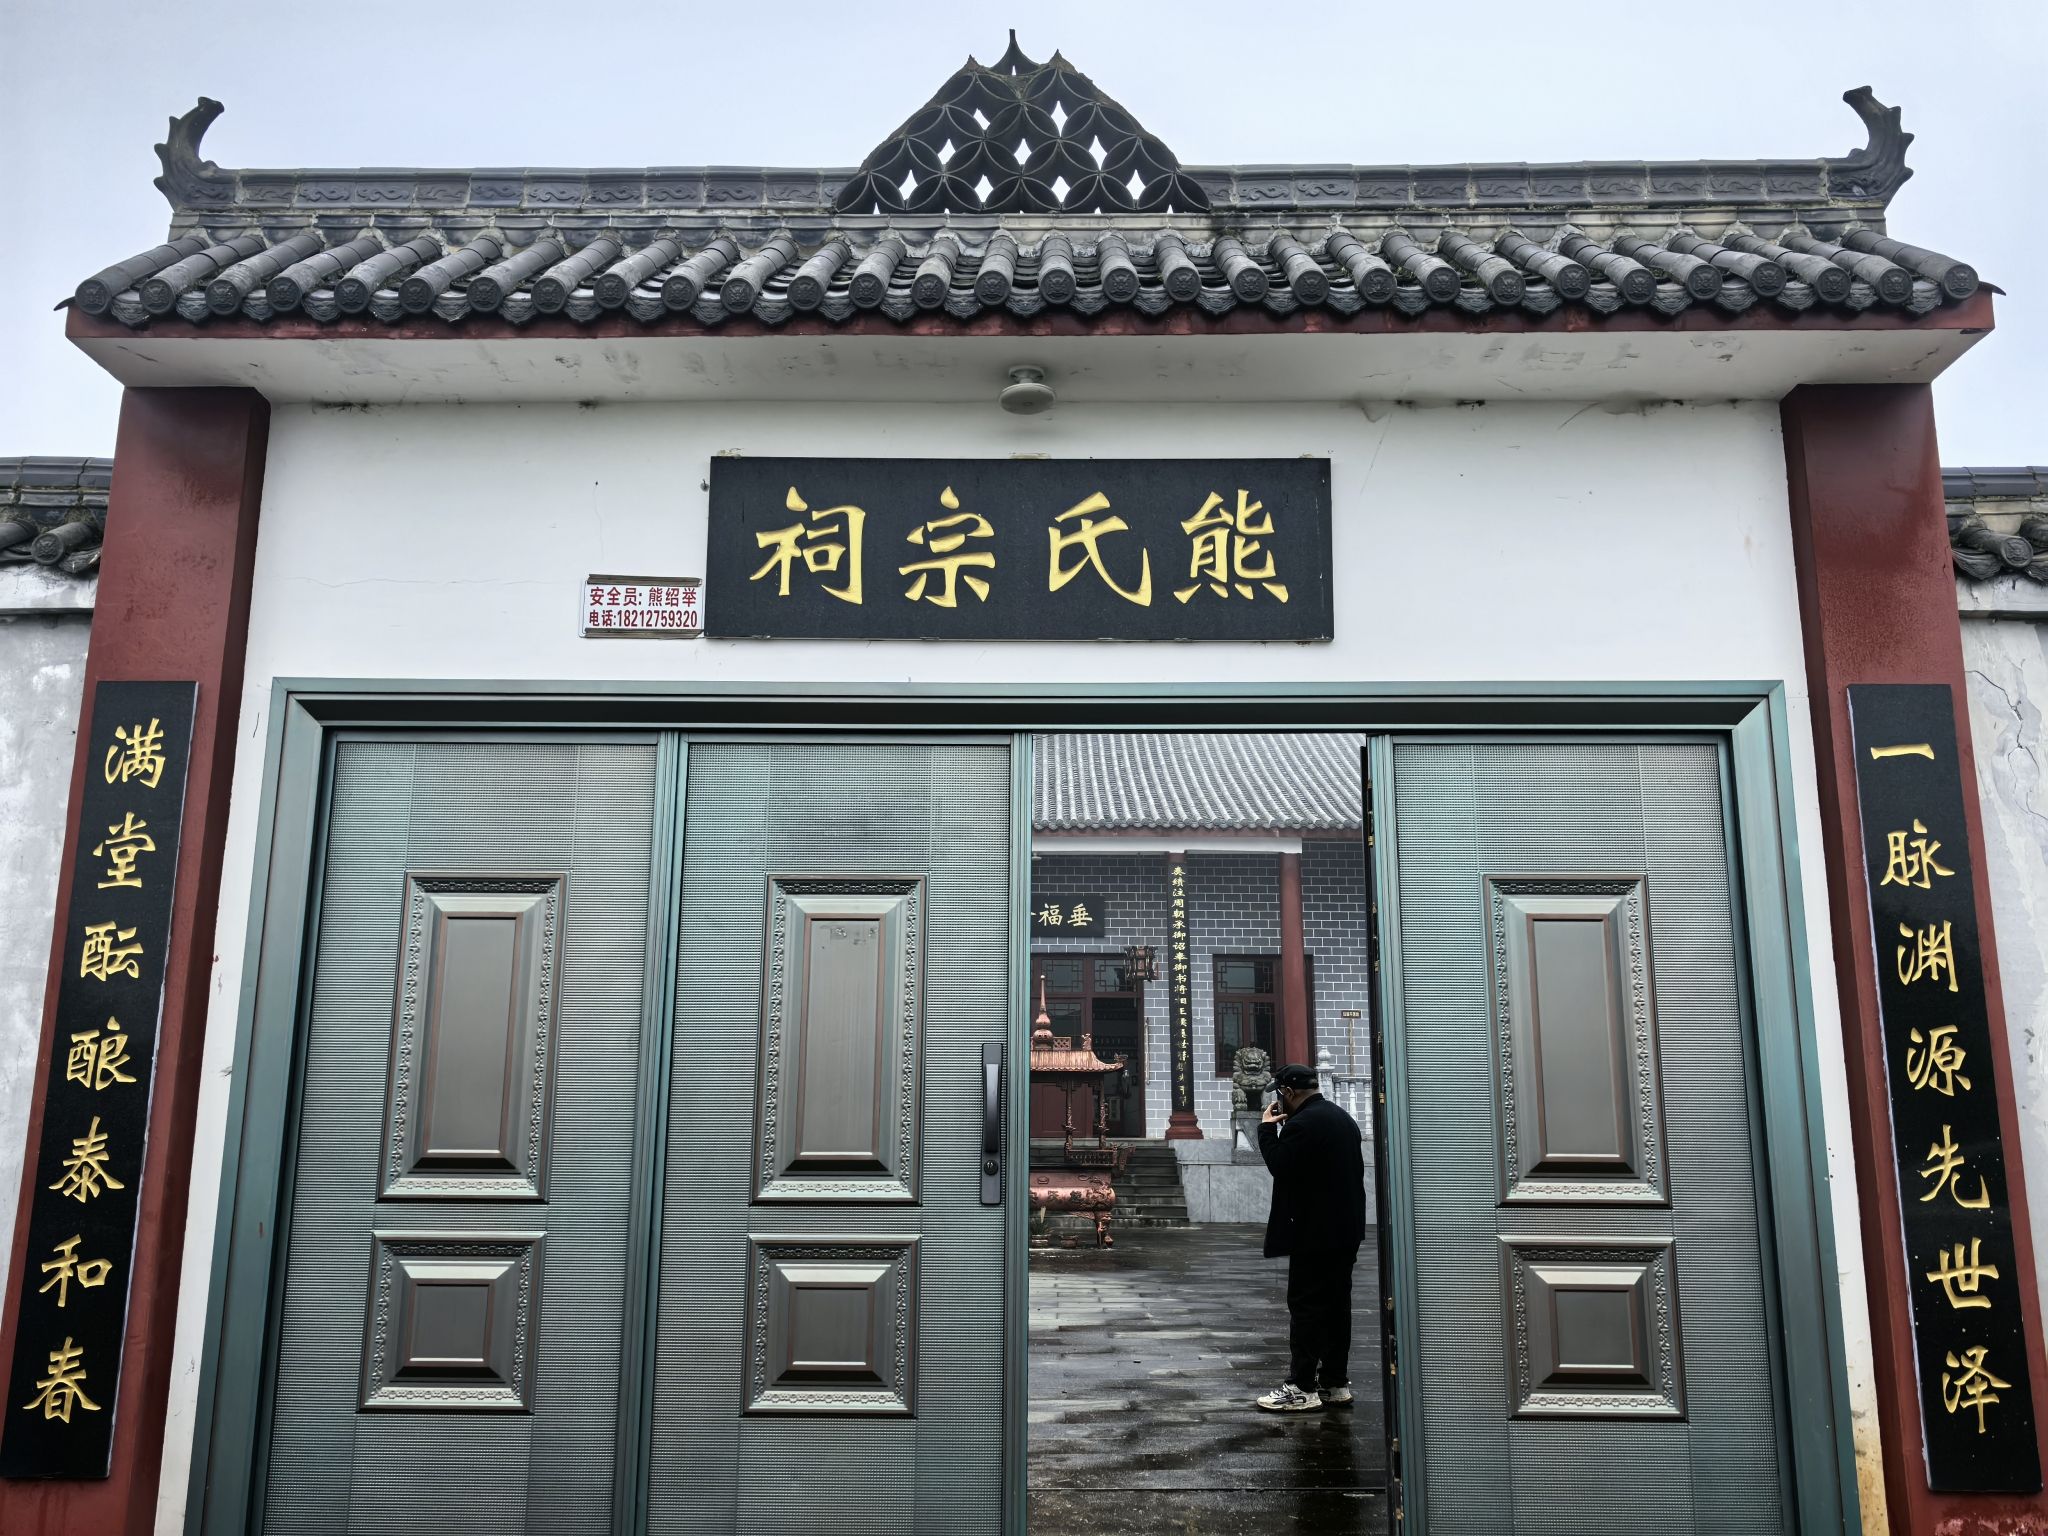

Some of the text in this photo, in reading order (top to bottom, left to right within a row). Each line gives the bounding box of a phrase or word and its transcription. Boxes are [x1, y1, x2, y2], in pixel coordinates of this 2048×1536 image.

[751, 486, 1289, 608] 熊氏宗祠
[23, 717, 165, 1424] 满堂酝酿泰和春
[1031, 903, 1093, 927] 垂福
[1870, 743, 2011, 1434] 一脉渊源先世泽
